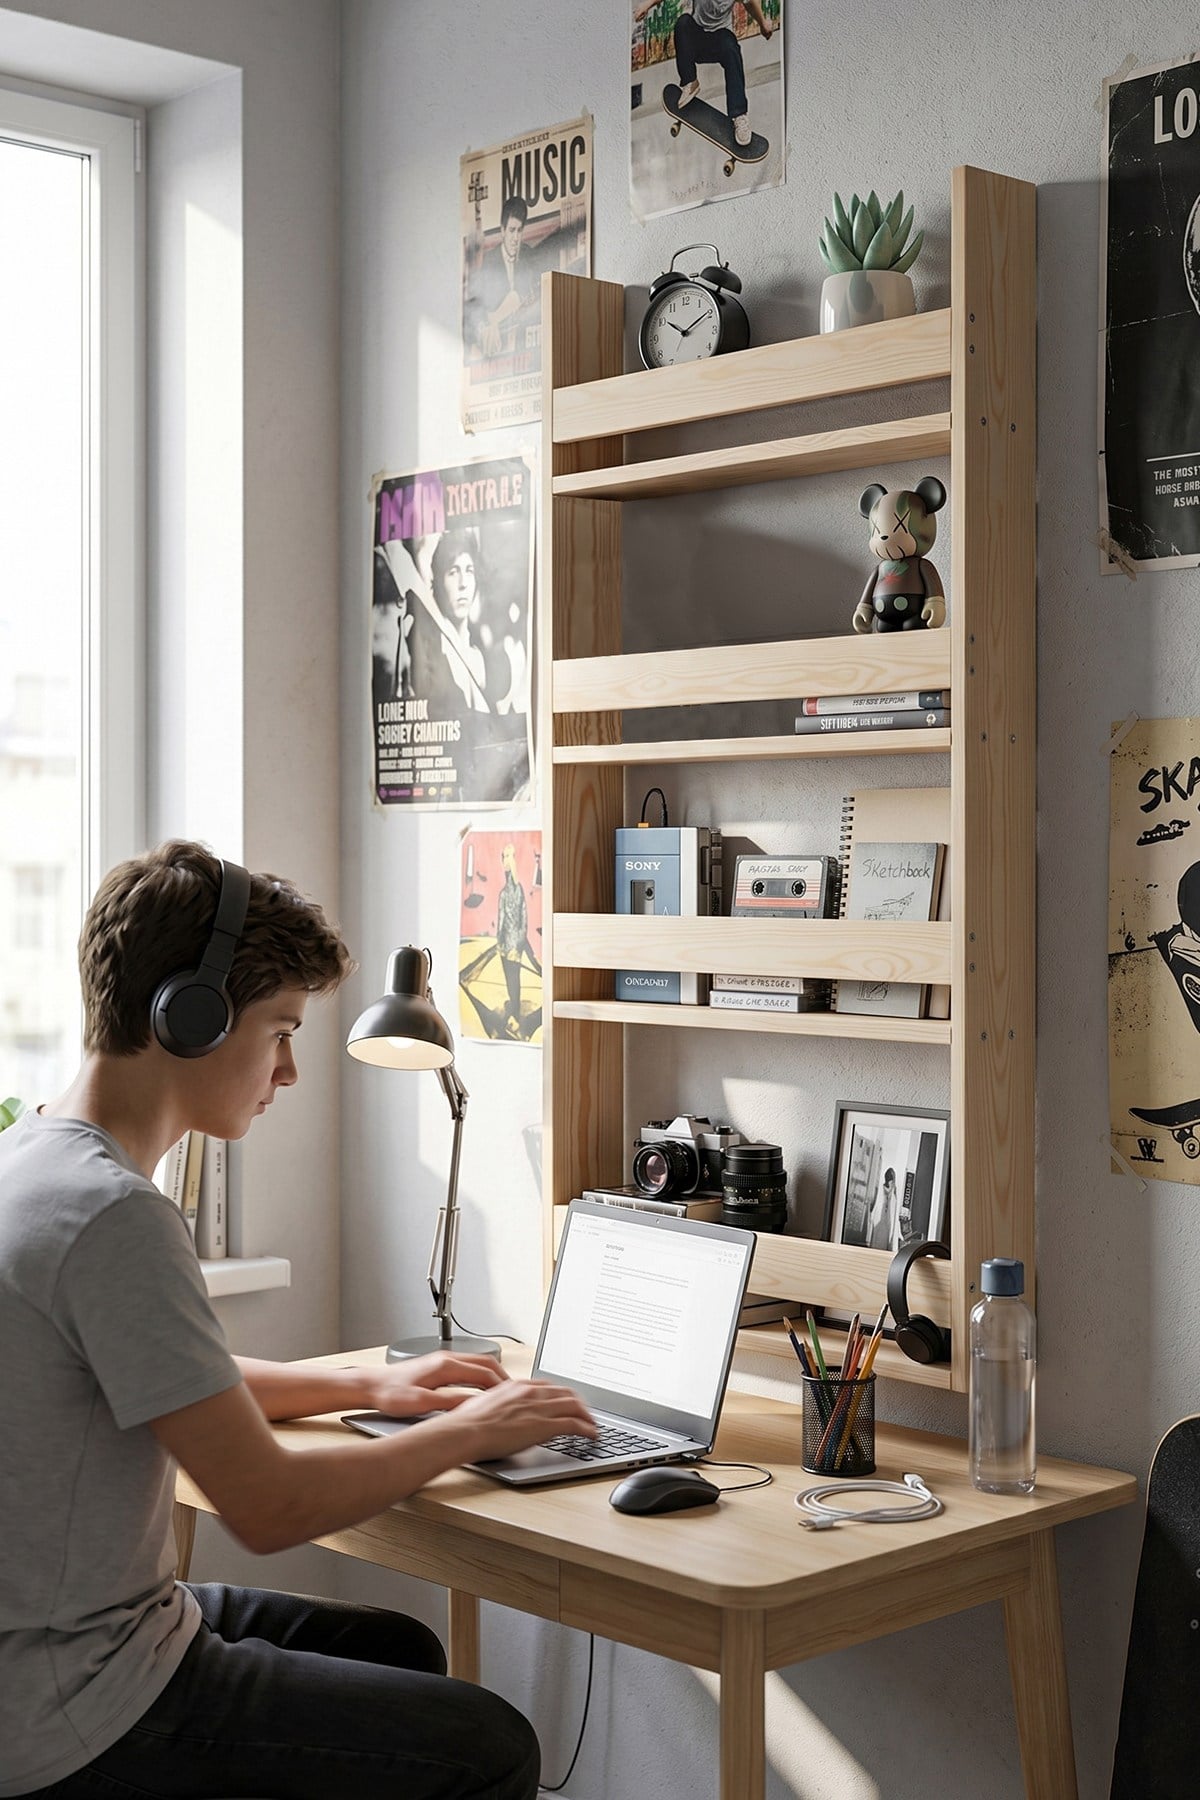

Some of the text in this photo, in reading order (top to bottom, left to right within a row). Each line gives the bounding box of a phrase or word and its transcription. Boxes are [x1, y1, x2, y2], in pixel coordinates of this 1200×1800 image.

[1154, 87, 1200, 145] LO
[501, 135, 586, 208] MUSIC
[682, 296, 690, 306] 12
[1153, 469, 1172, 480] THE
[1155, 482, 1182, 496] HORSE
[625, 861, 662, 871] SONY
